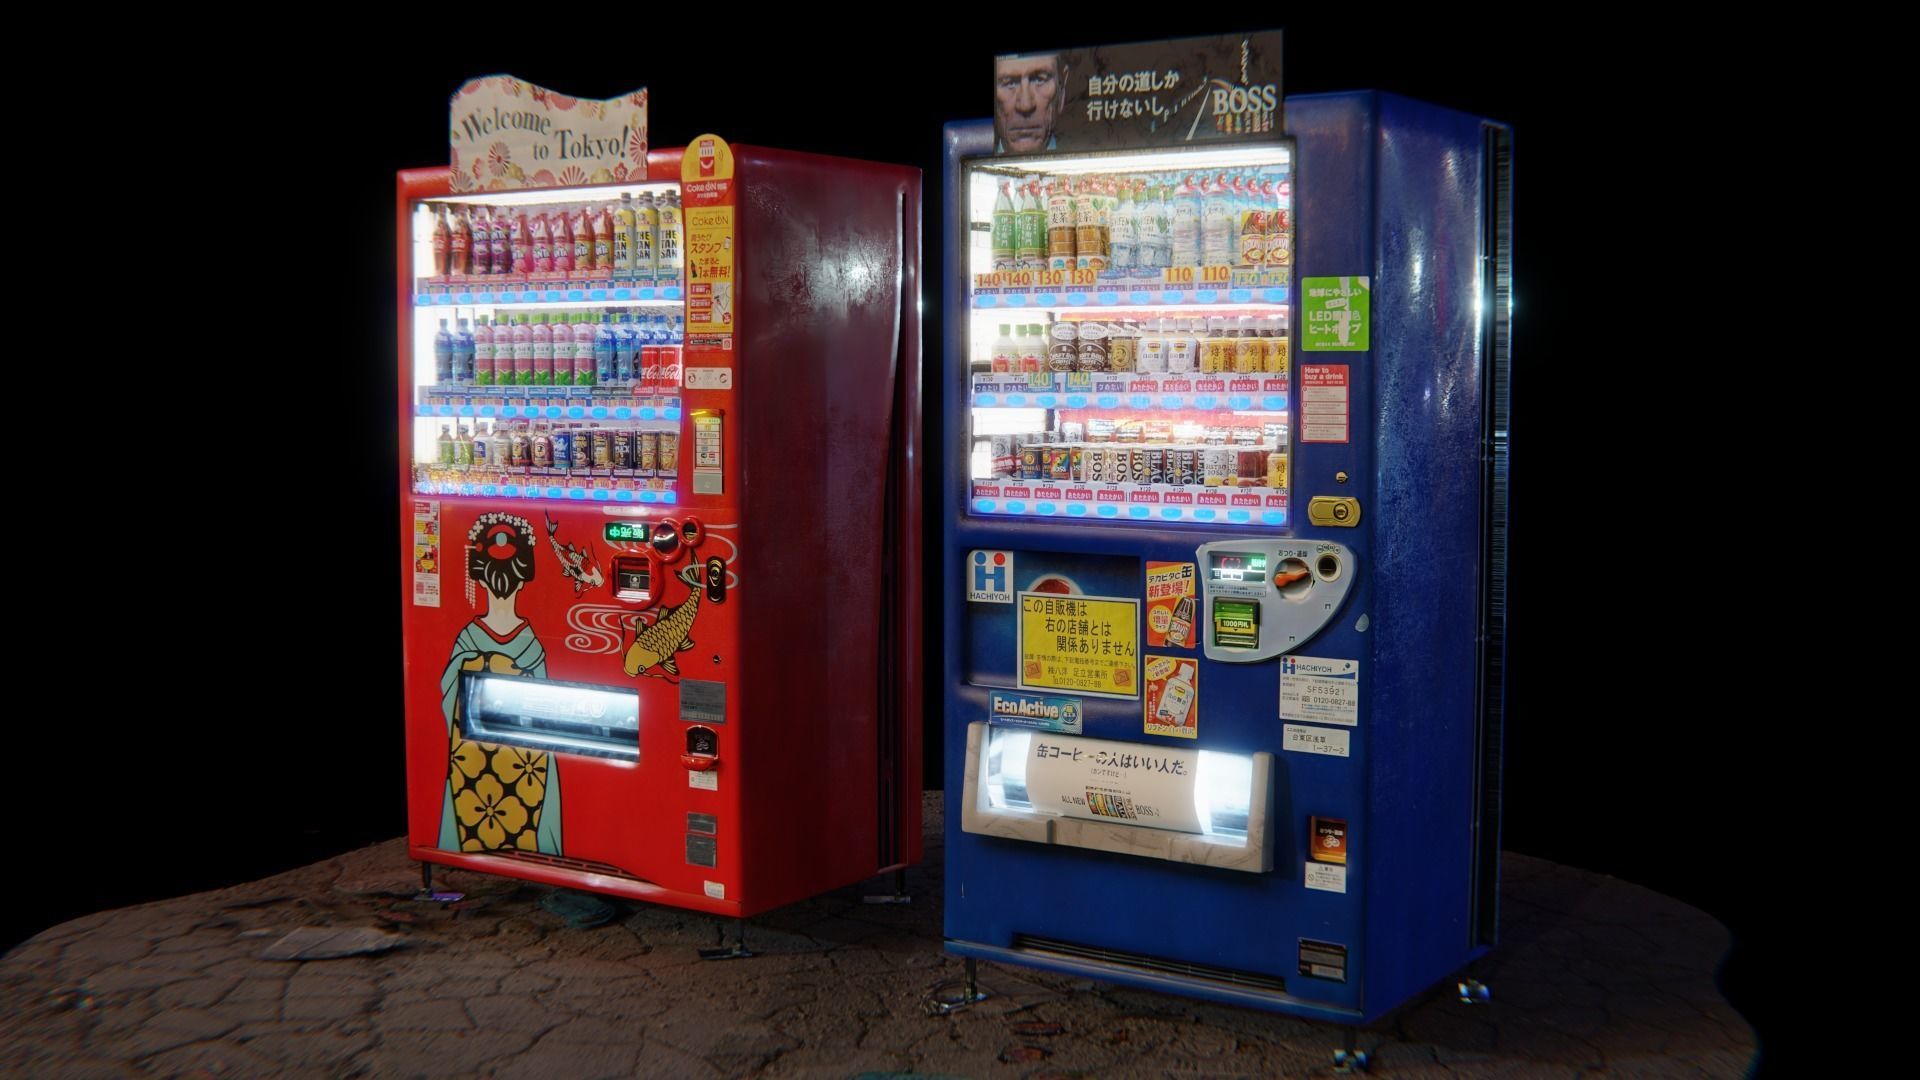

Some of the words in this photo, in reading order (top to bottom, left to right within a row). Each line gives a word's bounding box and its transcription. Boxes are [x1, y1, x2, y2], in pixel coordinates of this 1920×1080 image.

[1087, 70, 1179, 96] 自分の道しか
[1212, 84, 1277, 116] BOSS
[462, 106, 550, 142] Welcome
[533, 143, 549, 160] to
[554, 125, 629, 160] Tokyo!
[692, 216, 713, 226] Coke
[978, 274, 999, 287] 140
[1007, 272, 1031, 285] 140
[1038, 271, 1062, 285] 130
[1071, 270, 1094, 284] 130
[1166, 268, 1191, 282] 110
[1203, 267, 1229, 281] 110
[976, 488, 998, 496] あたたかい
[1005, 488, 1028, 497] あたたかい
[1037, 490, 1059, 498] あたたかい
[1068, 491, 1091, 499] あたたかい
[1100, 492, 1123, 500] あたたかい
[1133, 493, 1158, 502] あたたかい
[1166, 494, 1191, 503] あたたかい
[1199, 496, 1225, 504] あたたかい
[1233, 497, 1259, 505] あたたかい
[1148, 580, 1190, 598] 新登場!
[970, 592, 1010, 601] HACHIYOH
[1024, 599, 1087, 616] この自販機は
[1045, 617, 1112, 637] 右の店舗とは
[1223, 619, 1249, 629] 1000円札
[1056, 636, 1134, 657] 関係ありません
[1297, 664, 1332, 673] HACHIYOH
